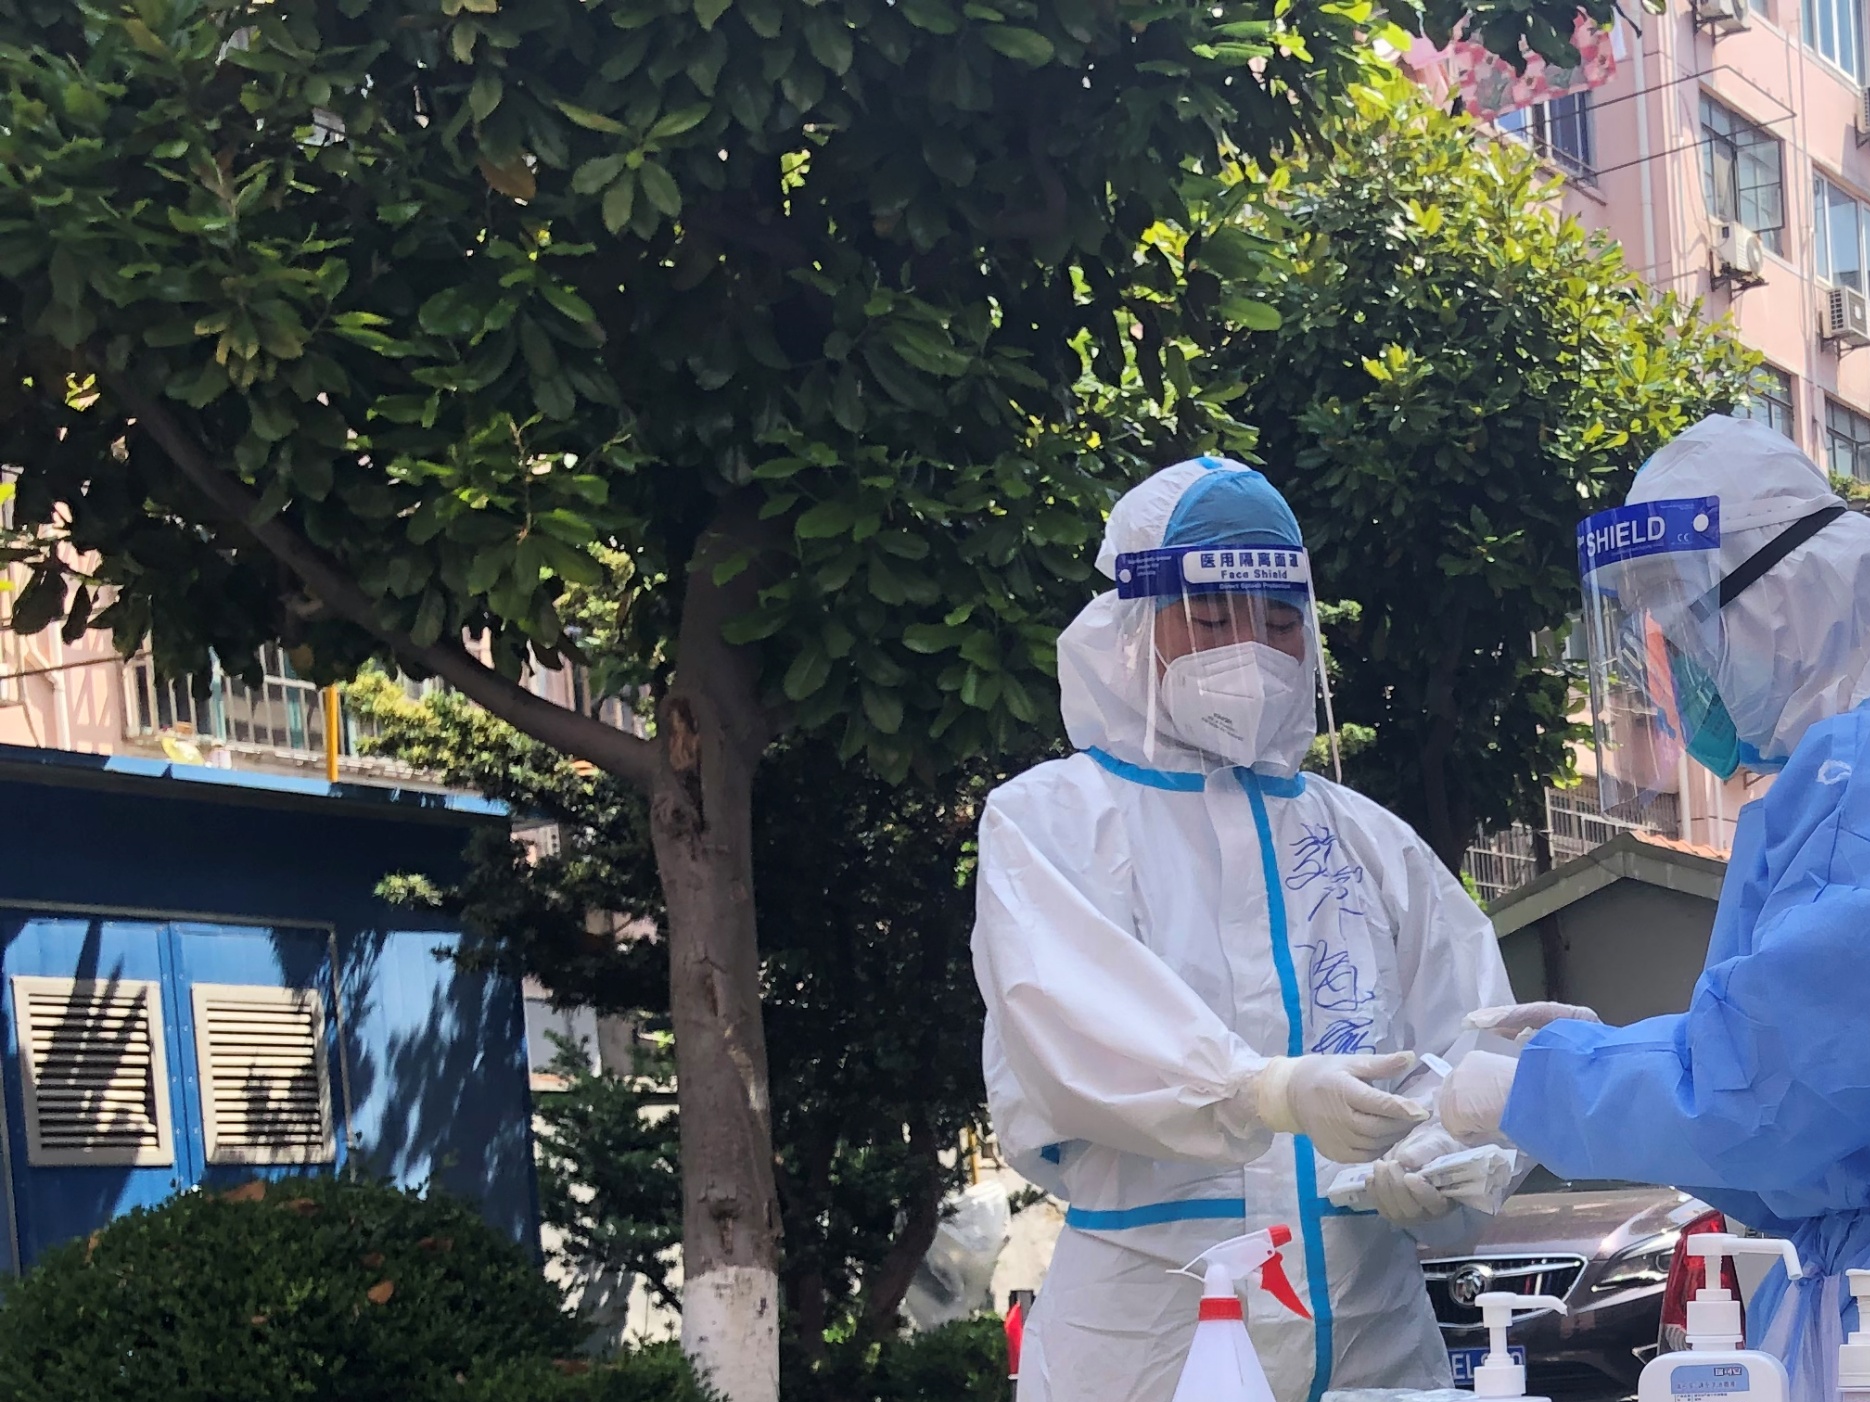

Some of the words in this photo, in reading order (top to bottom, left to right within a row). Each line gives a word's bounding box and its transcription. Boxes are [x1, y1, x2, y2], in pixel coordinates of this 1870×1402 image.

[1586, 516, 1666, 558] SHIELD
[1220, 569, 1250, 580] Face
[1254, 568, 1288, 580] Shield
